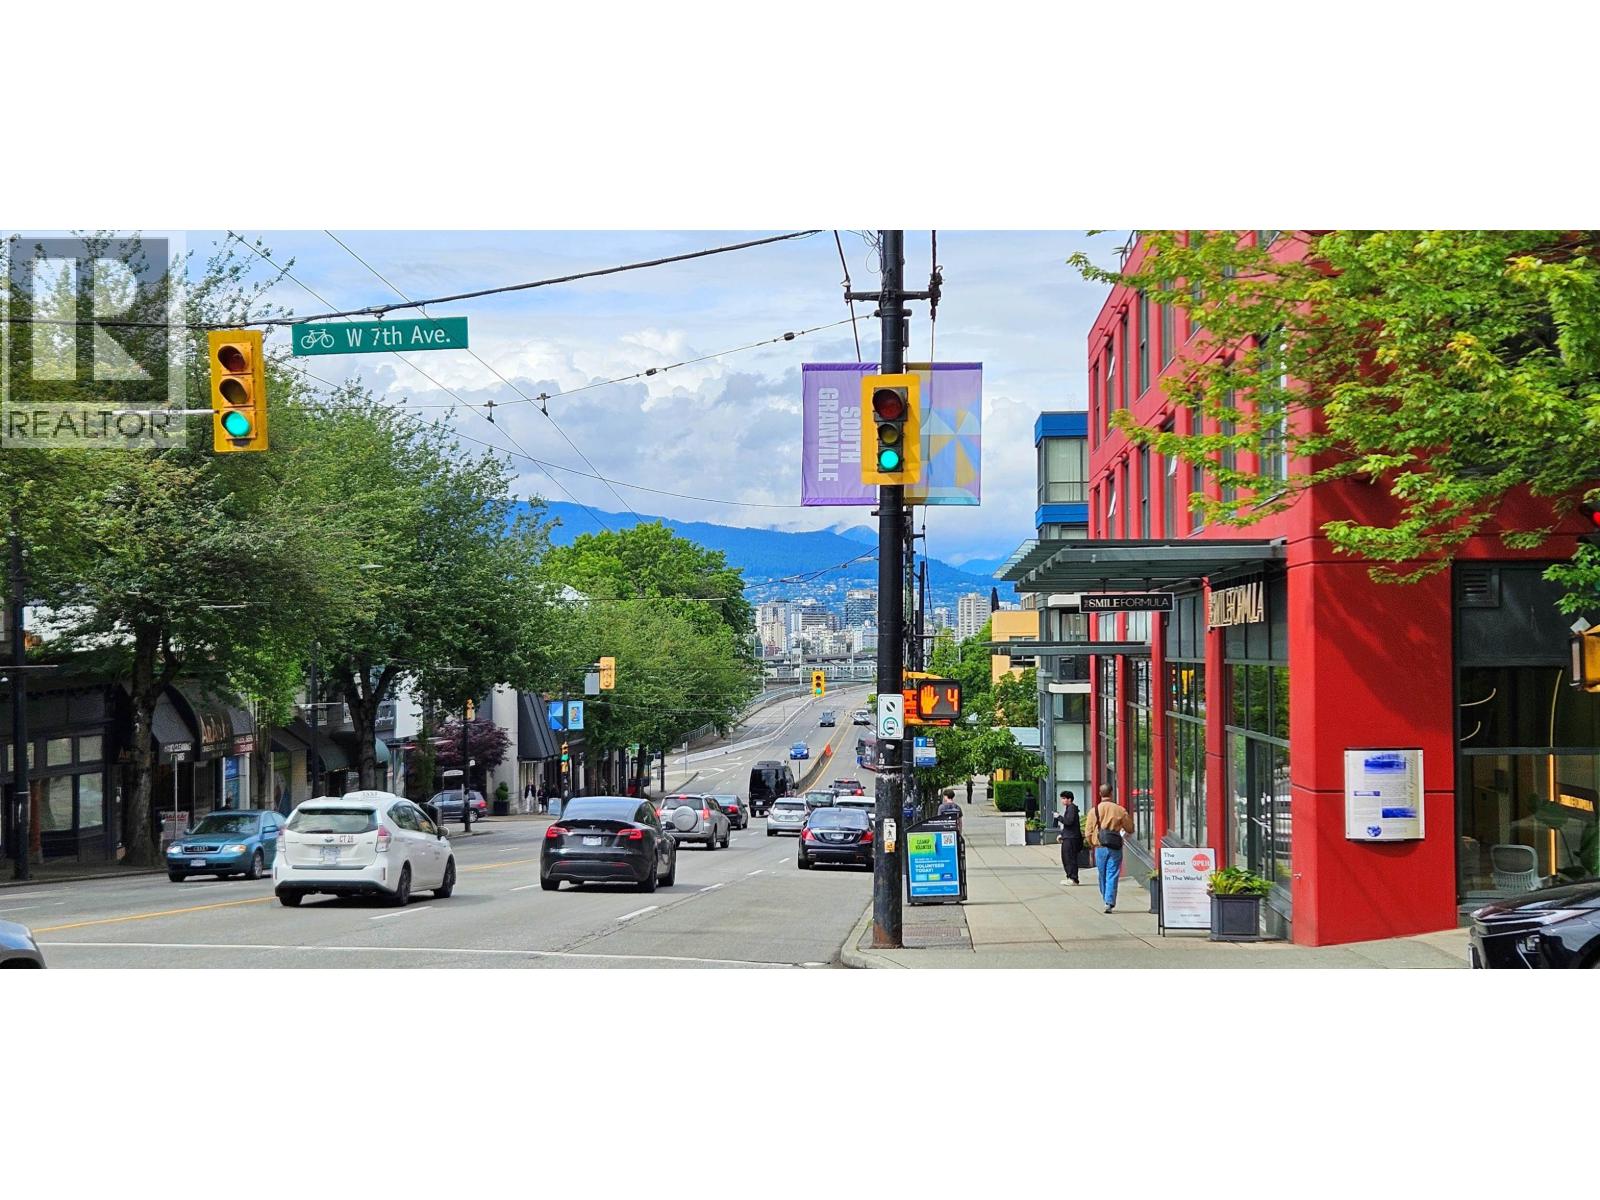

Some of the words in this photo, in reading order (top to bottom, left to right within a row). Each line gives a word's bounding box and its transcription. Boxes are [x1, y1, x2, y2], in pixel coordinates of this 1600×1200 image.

[346, 328, 363, 347] W
[371, 326, 402, 346] 7th
[410, 325, 451, 344] Ave.
[818, 387, 839, 481] GRANVILLE
[840, 406, 861, 463] SOUTH
[947, 688, 959, 712] 4
